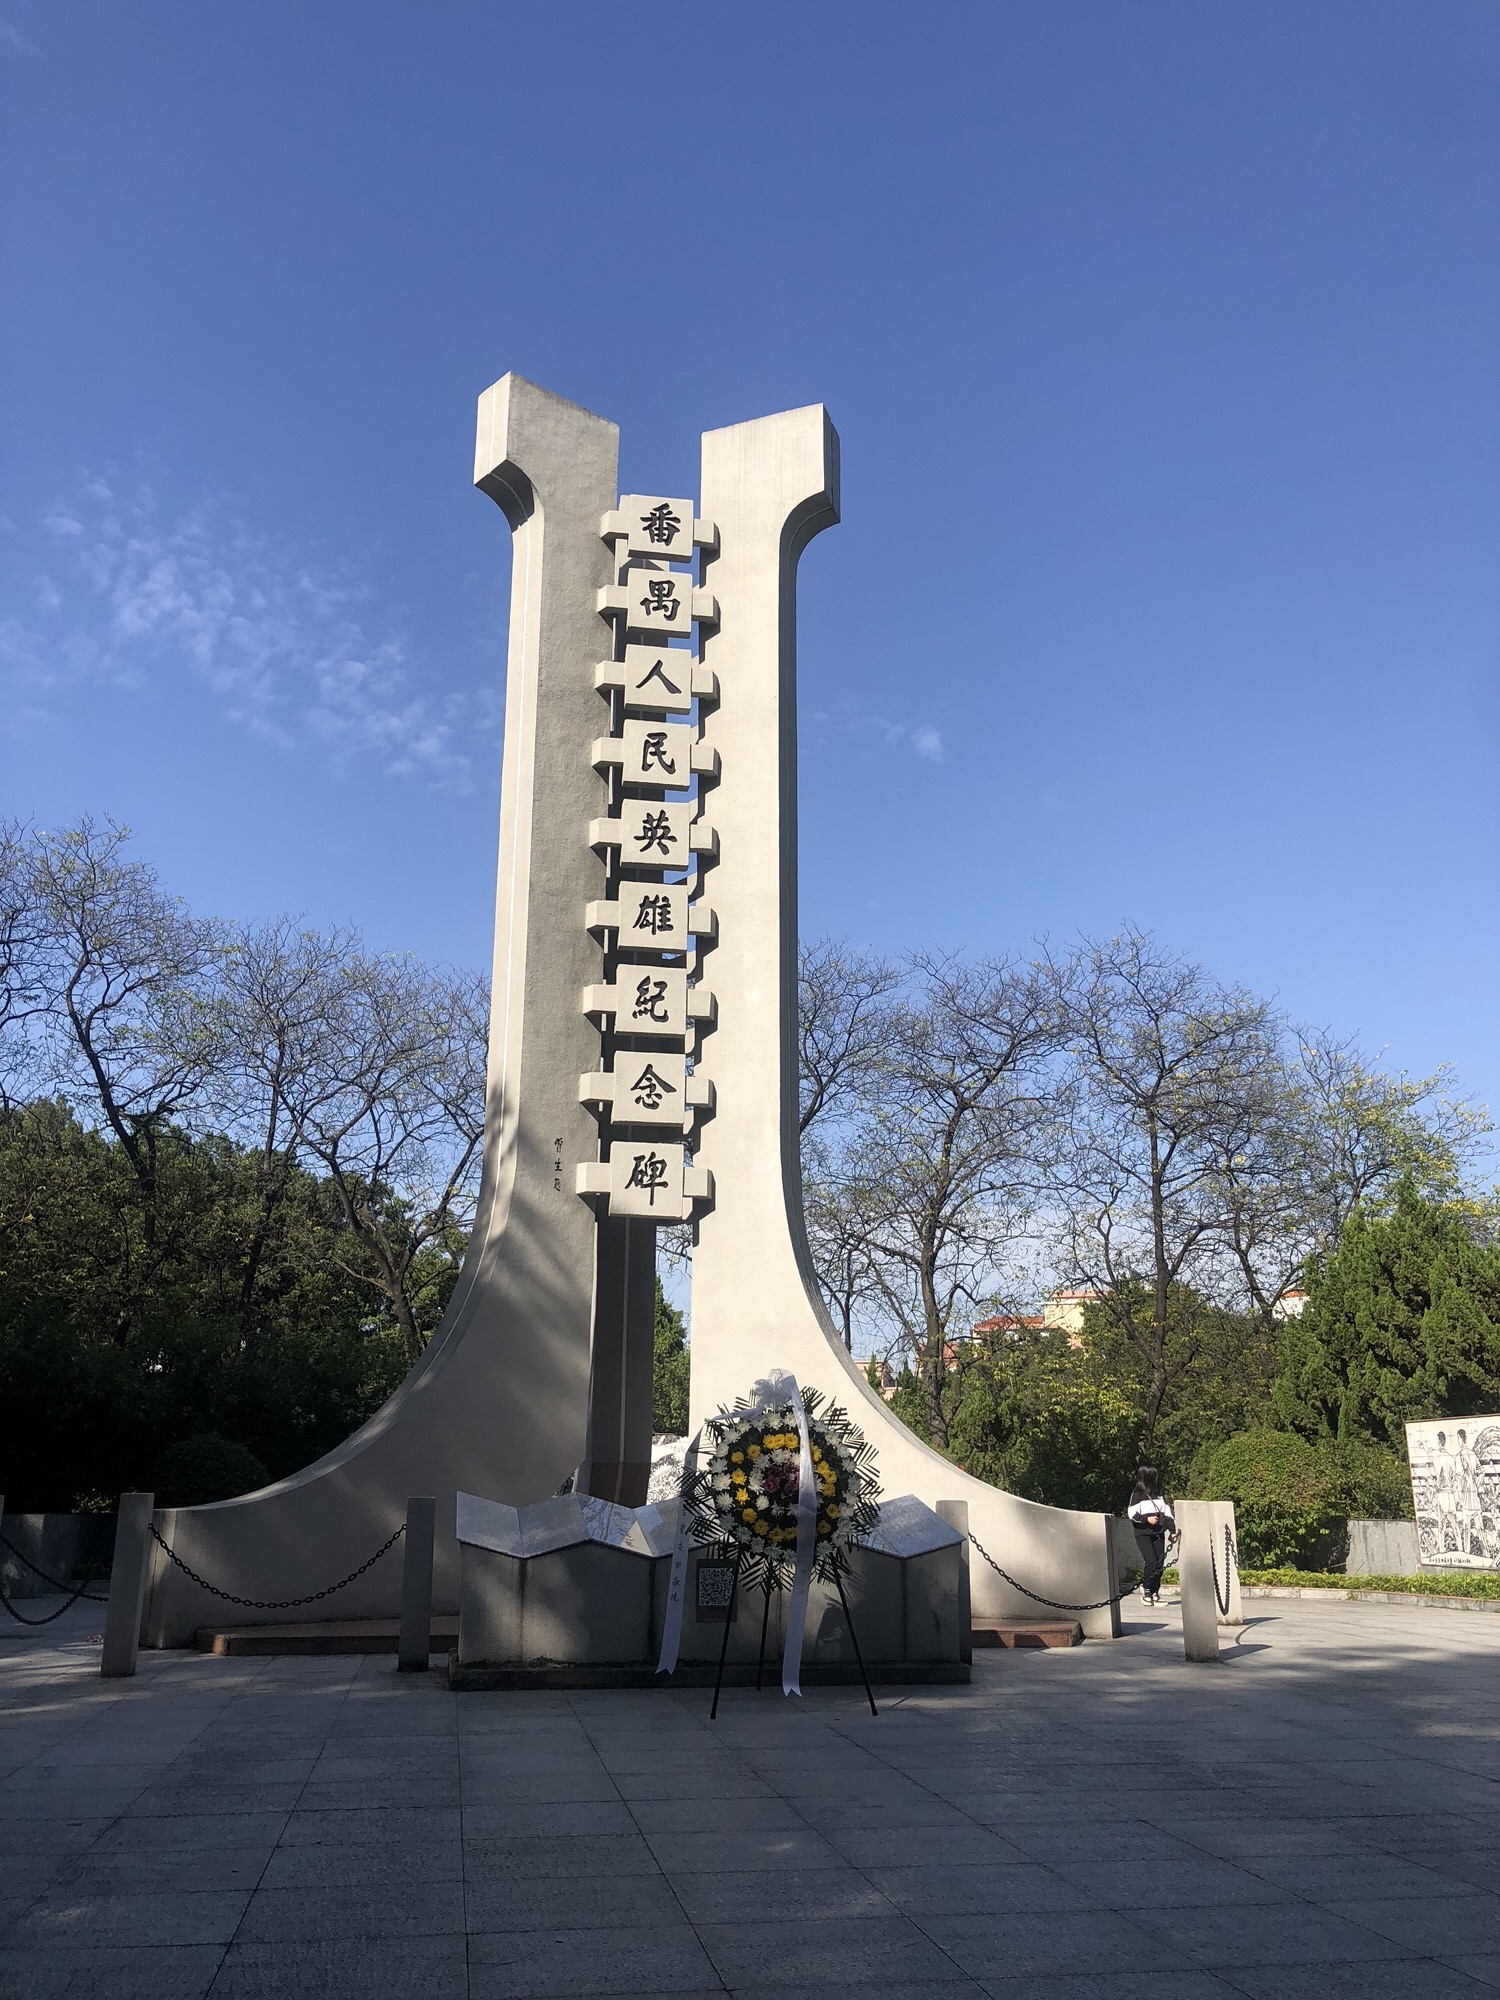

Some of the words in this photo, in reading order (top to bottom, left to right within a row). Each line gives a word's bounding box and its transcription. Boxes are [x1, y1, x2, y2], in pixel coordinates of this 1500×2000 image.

[624, 502, 682, 1206] 番禺人民英雄紀念碑
